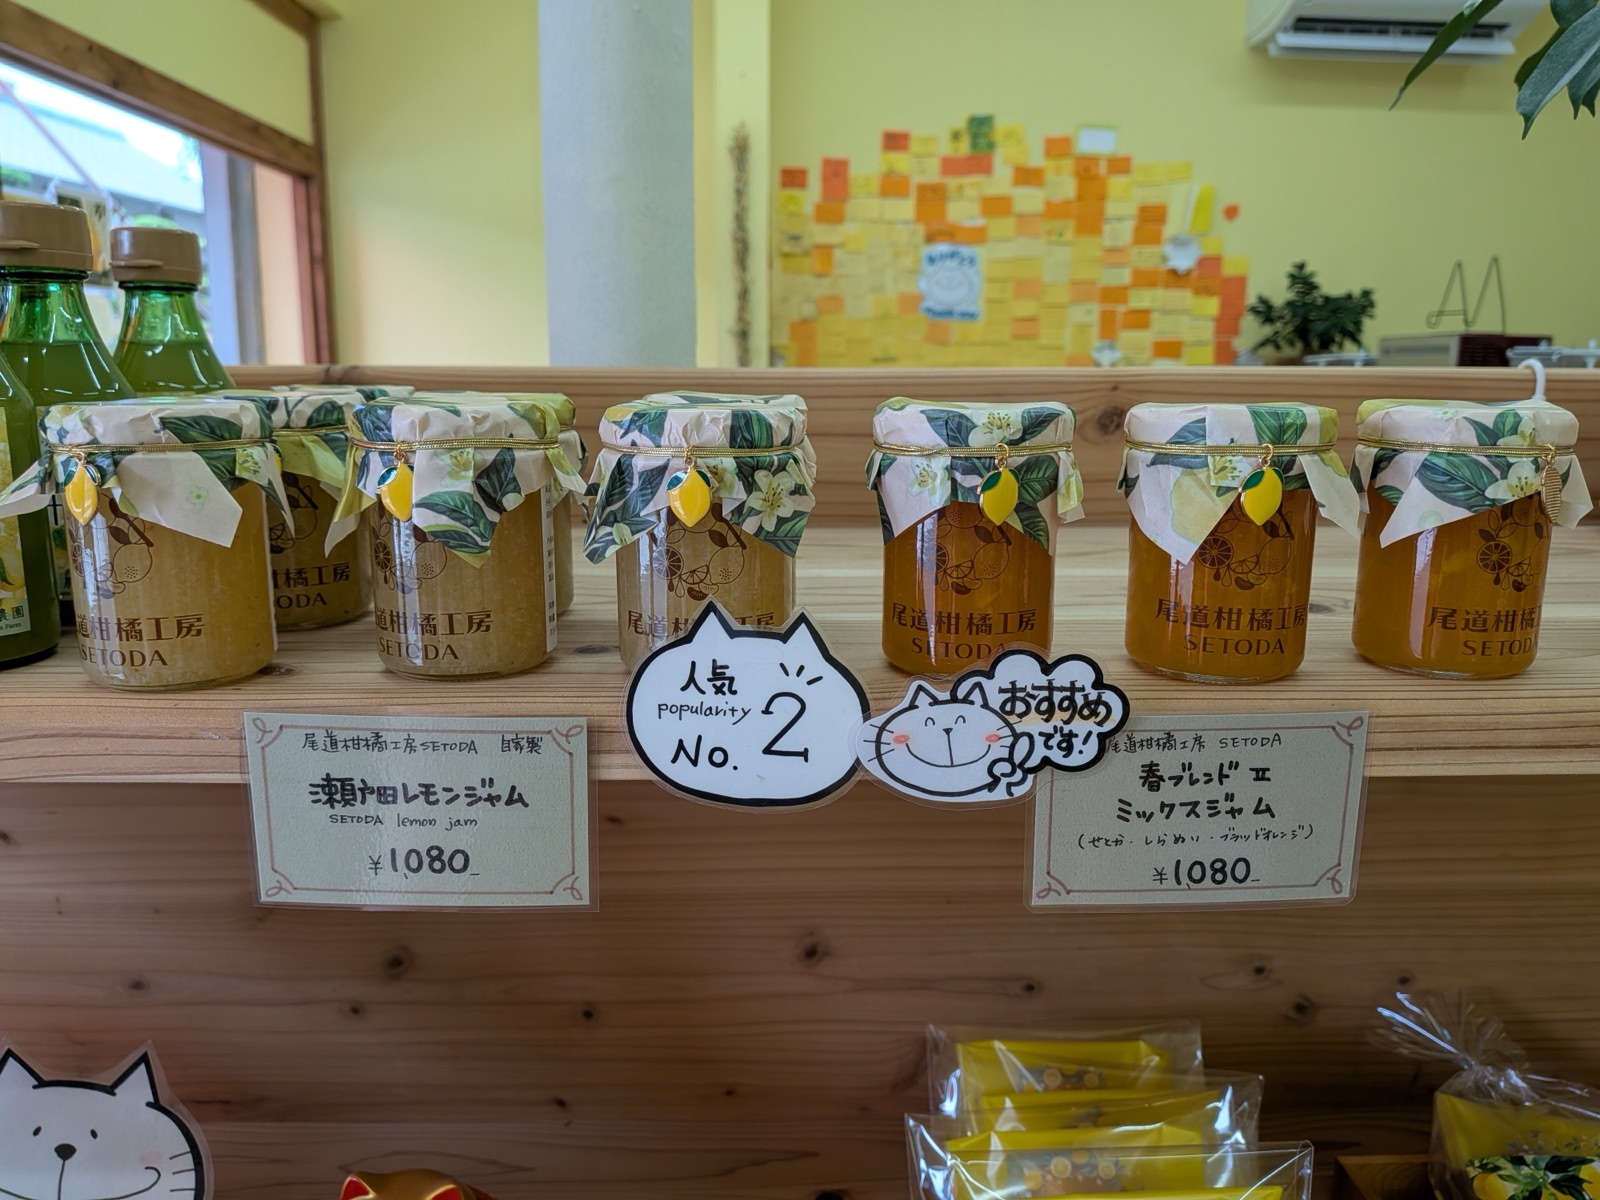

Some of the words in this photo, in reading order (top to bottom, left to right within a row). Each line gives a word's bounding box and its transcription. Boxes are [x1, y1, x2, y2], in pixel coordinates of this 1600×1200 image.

[272, 562, 350, 588] 橘工房
[892, 598, 1037, 636] 尾道柑橘工房
[1155, 598, 1307, 631] 尾道柑橘工房
[81, 644, 168, 667] SETODA
[380, 636, 459, 661] SETODA
[1184, 634, 1285, 655] SETODA
[680, 658, 738, 696] 人気
[657, 701, 752, 726] popularity
[998, 678, 1112, 727] おすすめ
[671, 734, 739, 771] No.
[761, 691, 809, 763] 2
[1039, 725, 1093, 758] です!
[1218, 732, 1282, 748] SETODA
[1139, 760, 1240, 792] 春ブレンド
[329, 813, 384, 826] SETODA
[397, 812, 437, 828] lemon
[444, 816, 478, 831] jam
[1116, 792, 1276, 823] ミックスジャム
